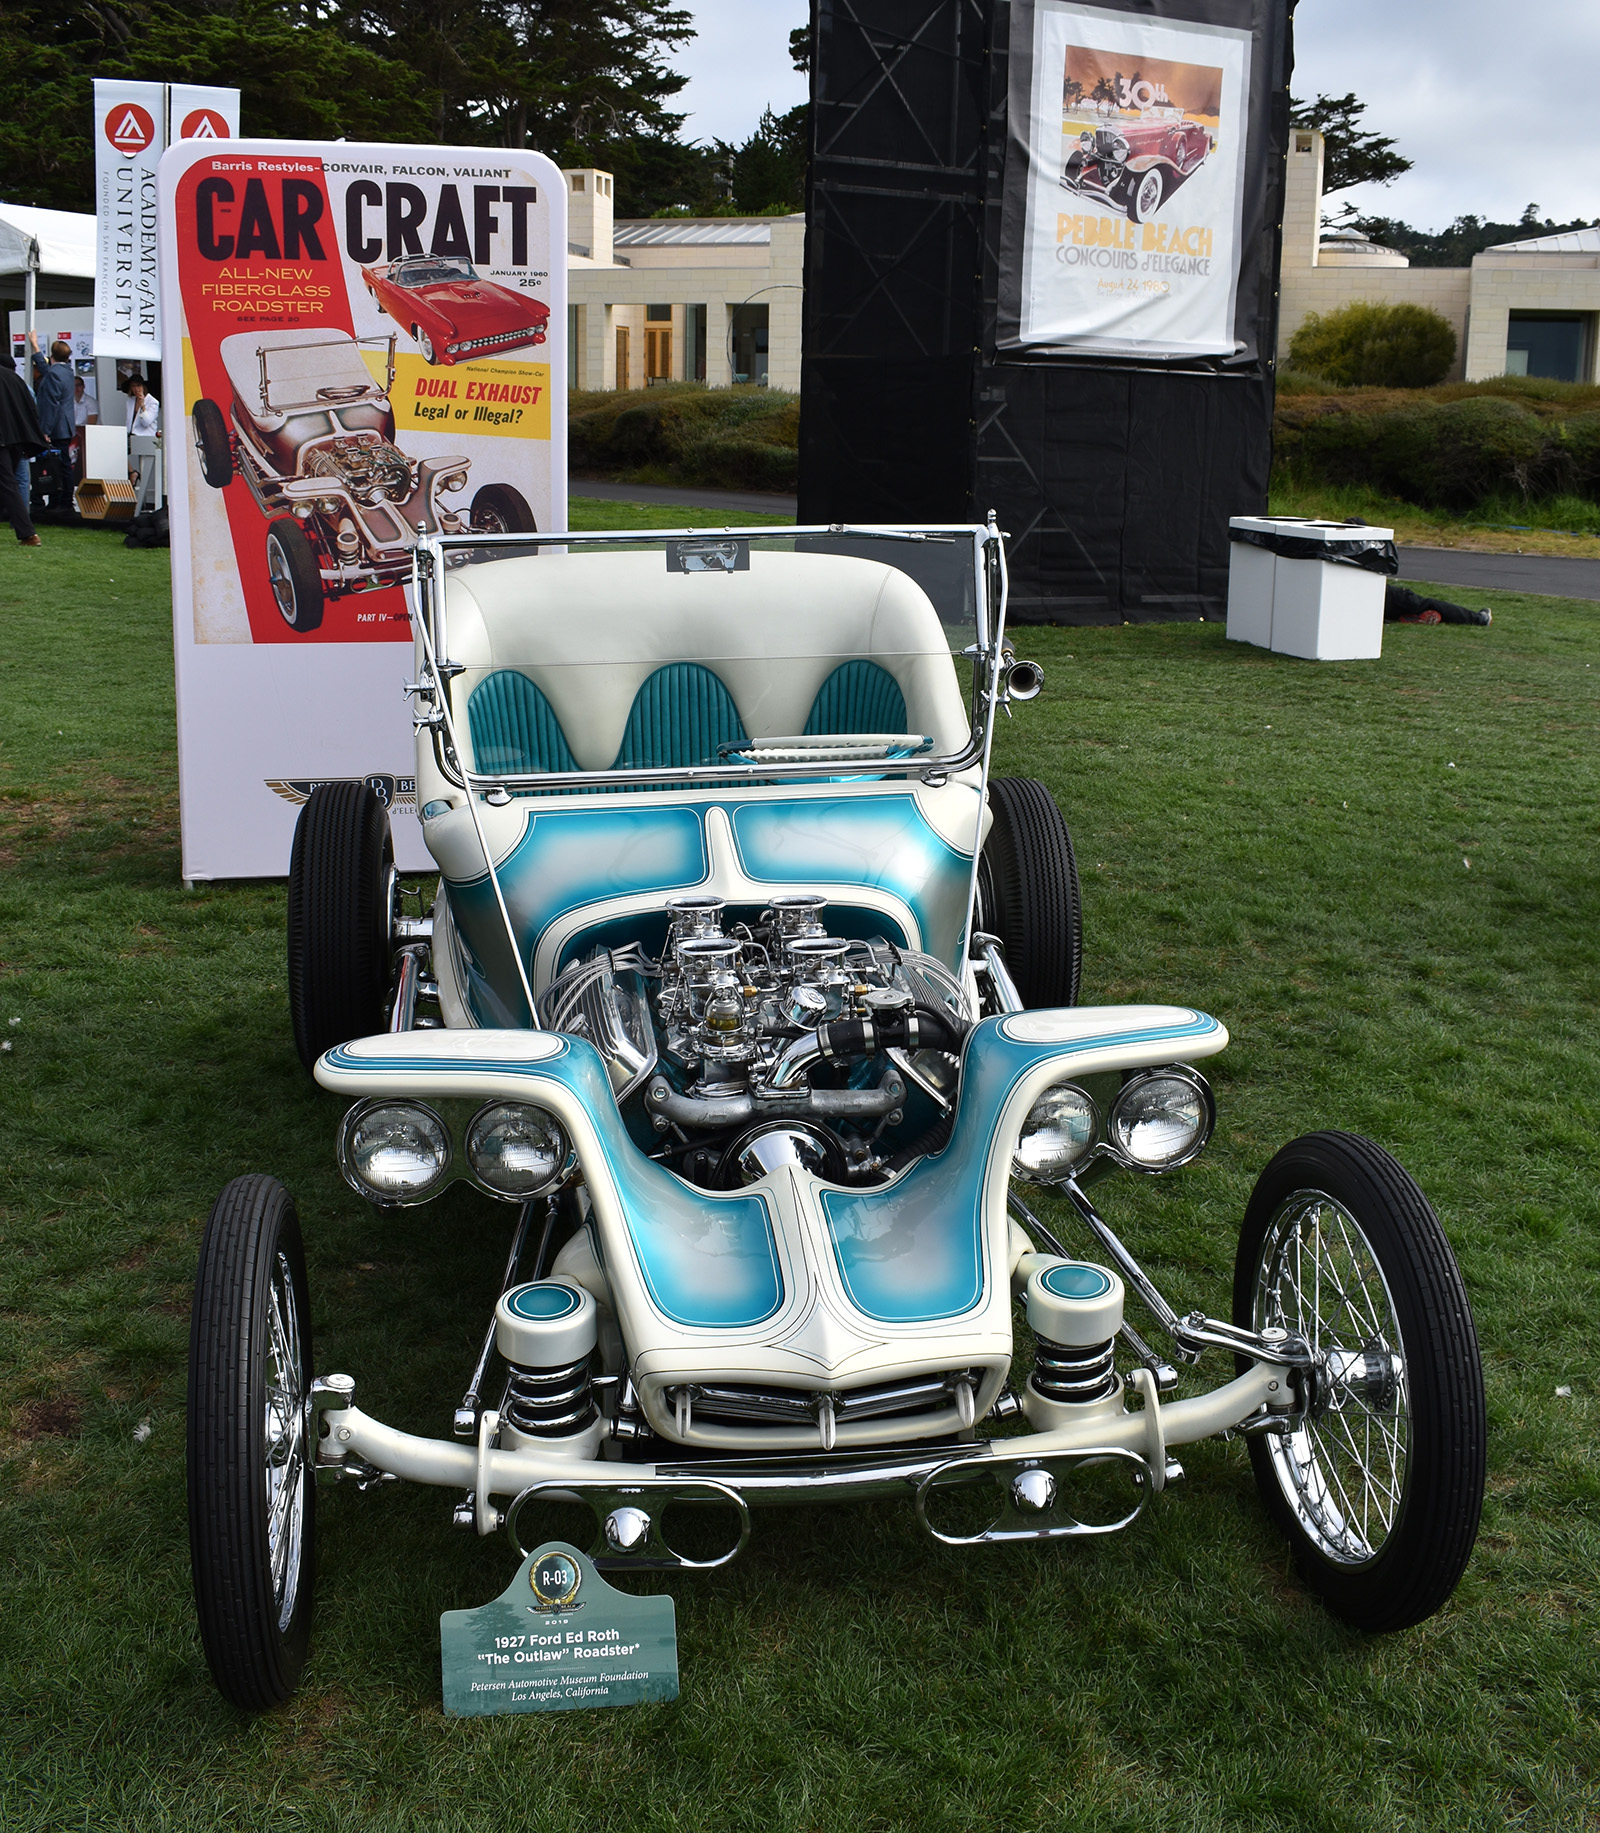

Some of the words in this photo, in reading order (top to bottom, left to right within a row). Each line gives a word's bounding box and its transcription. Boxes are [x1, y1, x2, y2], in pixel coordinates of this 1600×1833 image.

[1119, 78, 1169, 111] 30th
[212, 161, 253, 171] Barris
[392, 166, 450, 178] FALCON,
[453, 167, 511, 178] VALIANT
[102, 171, 110, 217] FOUNDED
[103, 221, 109, 231] IN
[141, 167, 157, 278] ACADEMY
[195, 176, 328, 262] CAR
[345, 179, 537, 267] CRAFT
[1056, 212, 1136, 250] PEBBLE
[1142, 222, 1213, 258] BEACH
[115, 167, 133, 339] UNIVERSITY
[1056, 245, 1138, 271] CONCOURS
[1141, 252, 1210, 277] d'ELEGANCE
[101, 256, 109, 309] FRANCISCO
[219, 267, 313, 280] ALL-NEW
[135, 279, 156, 300] of
[202, 283, 332, 298] FIBERGLASS
[1127, 278, 1139, 291] 24
[1142, 279, 1171, 293] 1980
[212, 300, 324, 313] ROADSTER
[139, 297, 156, 341] ART
[490, 367, 517, 376] Champion
[415, 377, 458, 399] DUAL
[465, 381, 543, 405] EXHAUST
[414, 401, 450, 421] Legal
[454, 407, 469, 420] or
[473, 405, 524, 426] Illegal?
[357, 613, 376, 622] PART
[542, 1569, 568, 1586] R-03
[494, 1635, 526, 1649] 1927
[530, 1632, 562, 1647] Ford
[566, 1631, 584, 1644] Ed
[588, 1628, 620, 1642] Roth
[477, 1652, 510, 1666] “The
[514, 1648, 570, 1664] Outlaw”
[471, 1681, 506, 1692] Petersen
[508, 1677, 558, 1690] Automotive
[560, 1674, 597, 1686] Museum
[599, 1670, 649, 1683] Foundation
[511, 1691, 527, 1702] Los
[528, 1688, 563, 1703] Angeles,
[565, 1685, 609, 1699] California
